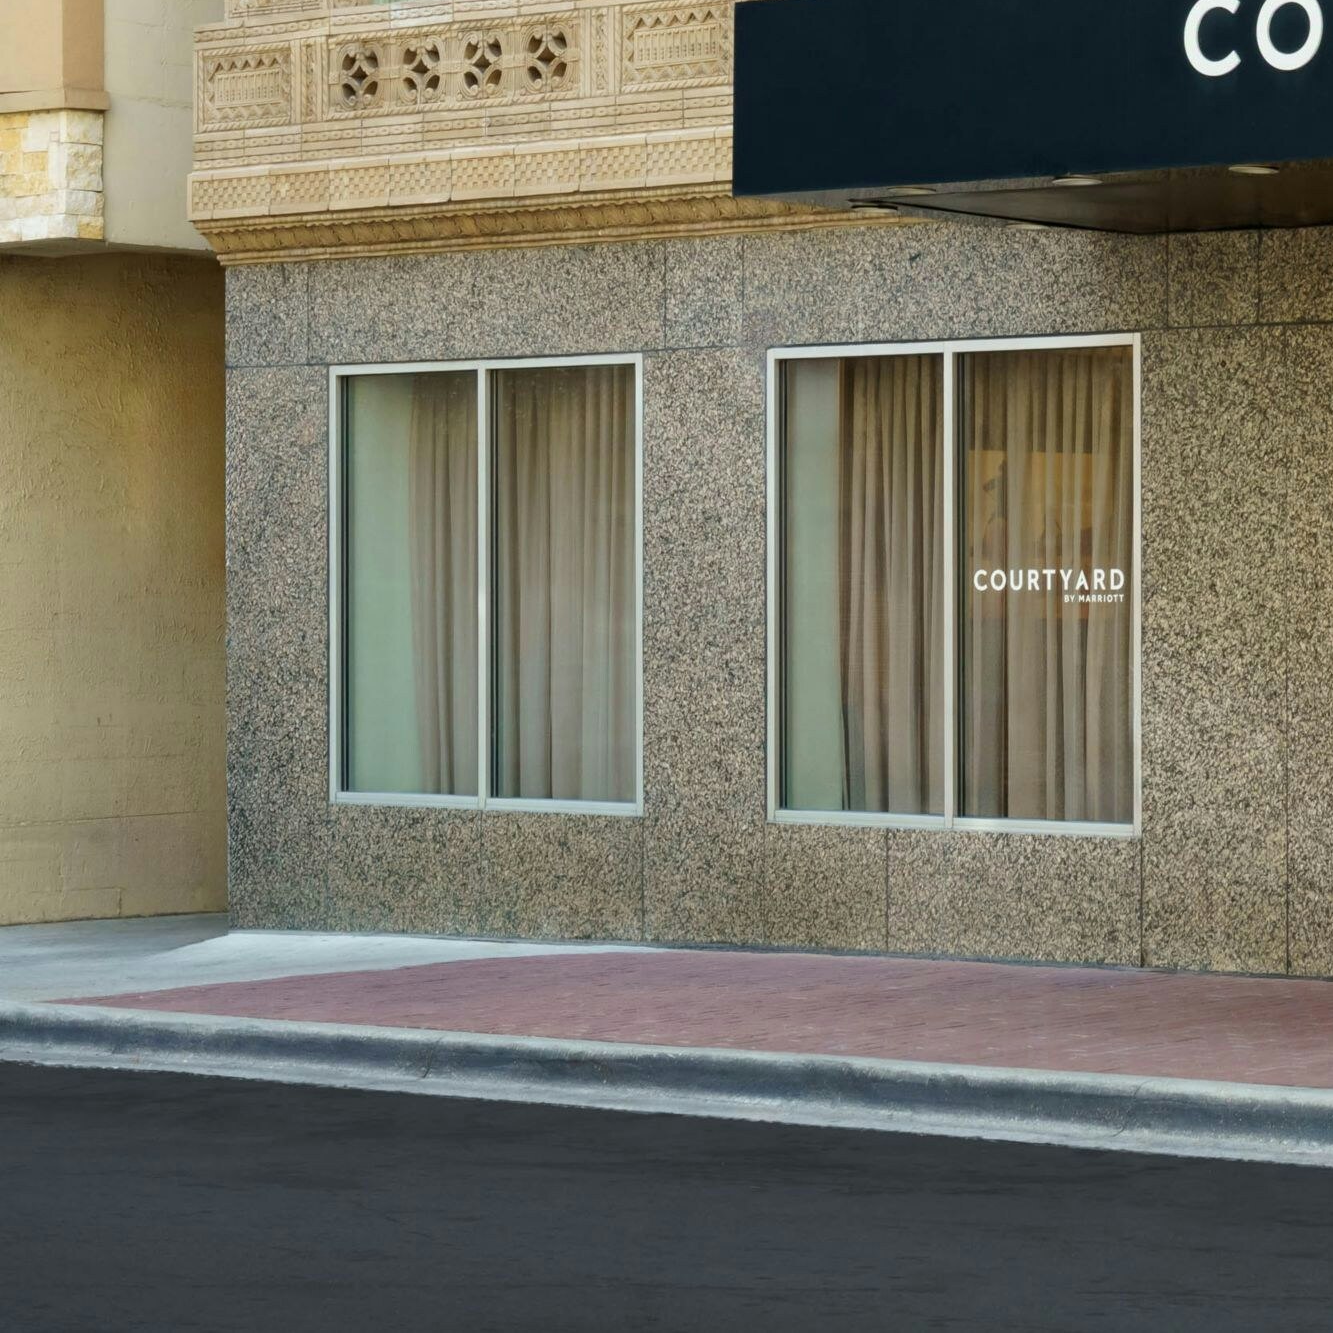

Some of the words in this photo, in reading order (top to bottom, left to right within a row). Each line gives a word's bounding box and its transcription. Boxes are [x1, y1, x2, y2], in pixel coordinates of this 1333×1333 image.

[973, 568, 1125, 591] COURTYARD
[1064, 594, 1075, 603] BY
[1078, 594, 1125, 603] MARRIOTT
